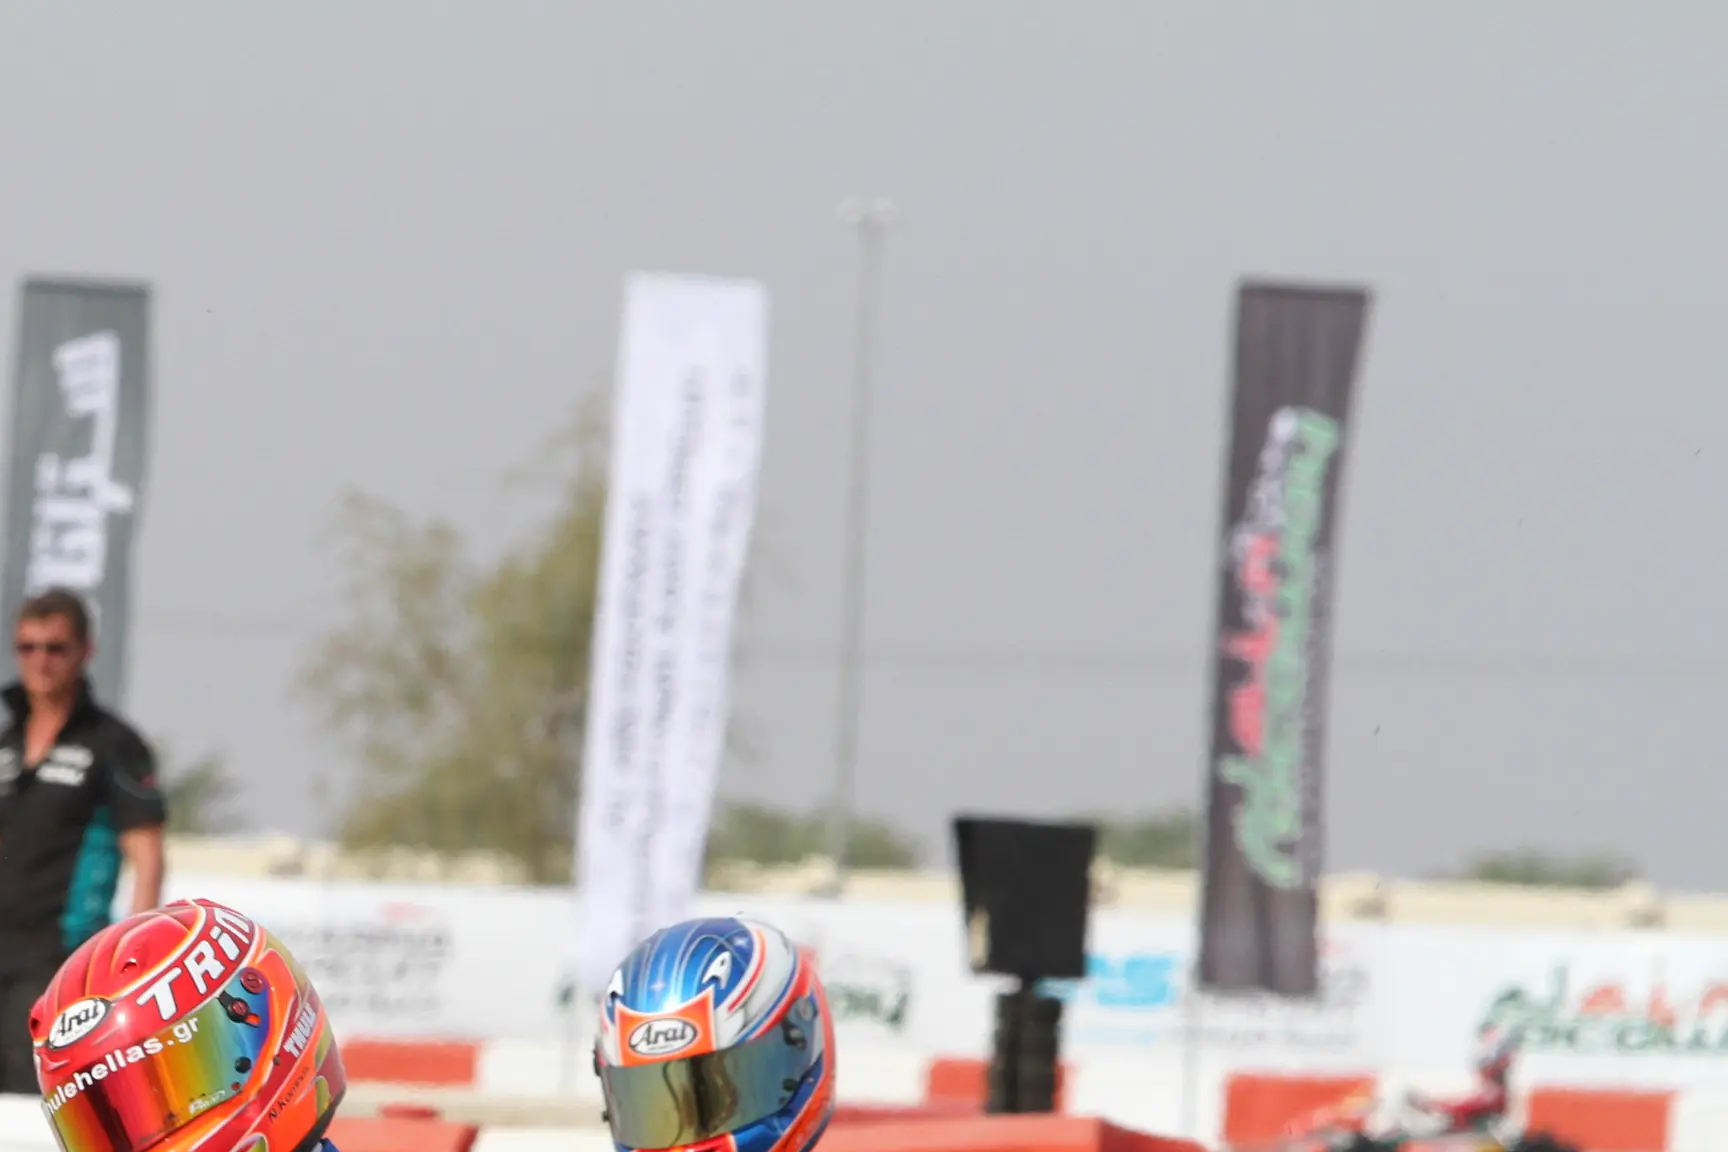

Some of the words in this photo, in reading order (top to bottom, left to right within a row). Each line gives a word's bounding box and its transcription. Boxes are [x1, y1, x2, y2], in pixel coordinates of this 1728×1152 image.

[55, 999, 100, 1037] Arai
[629, 1021, 688, 1048] Arai
[46, 1016, 199, 1116] hulehellas.gr
